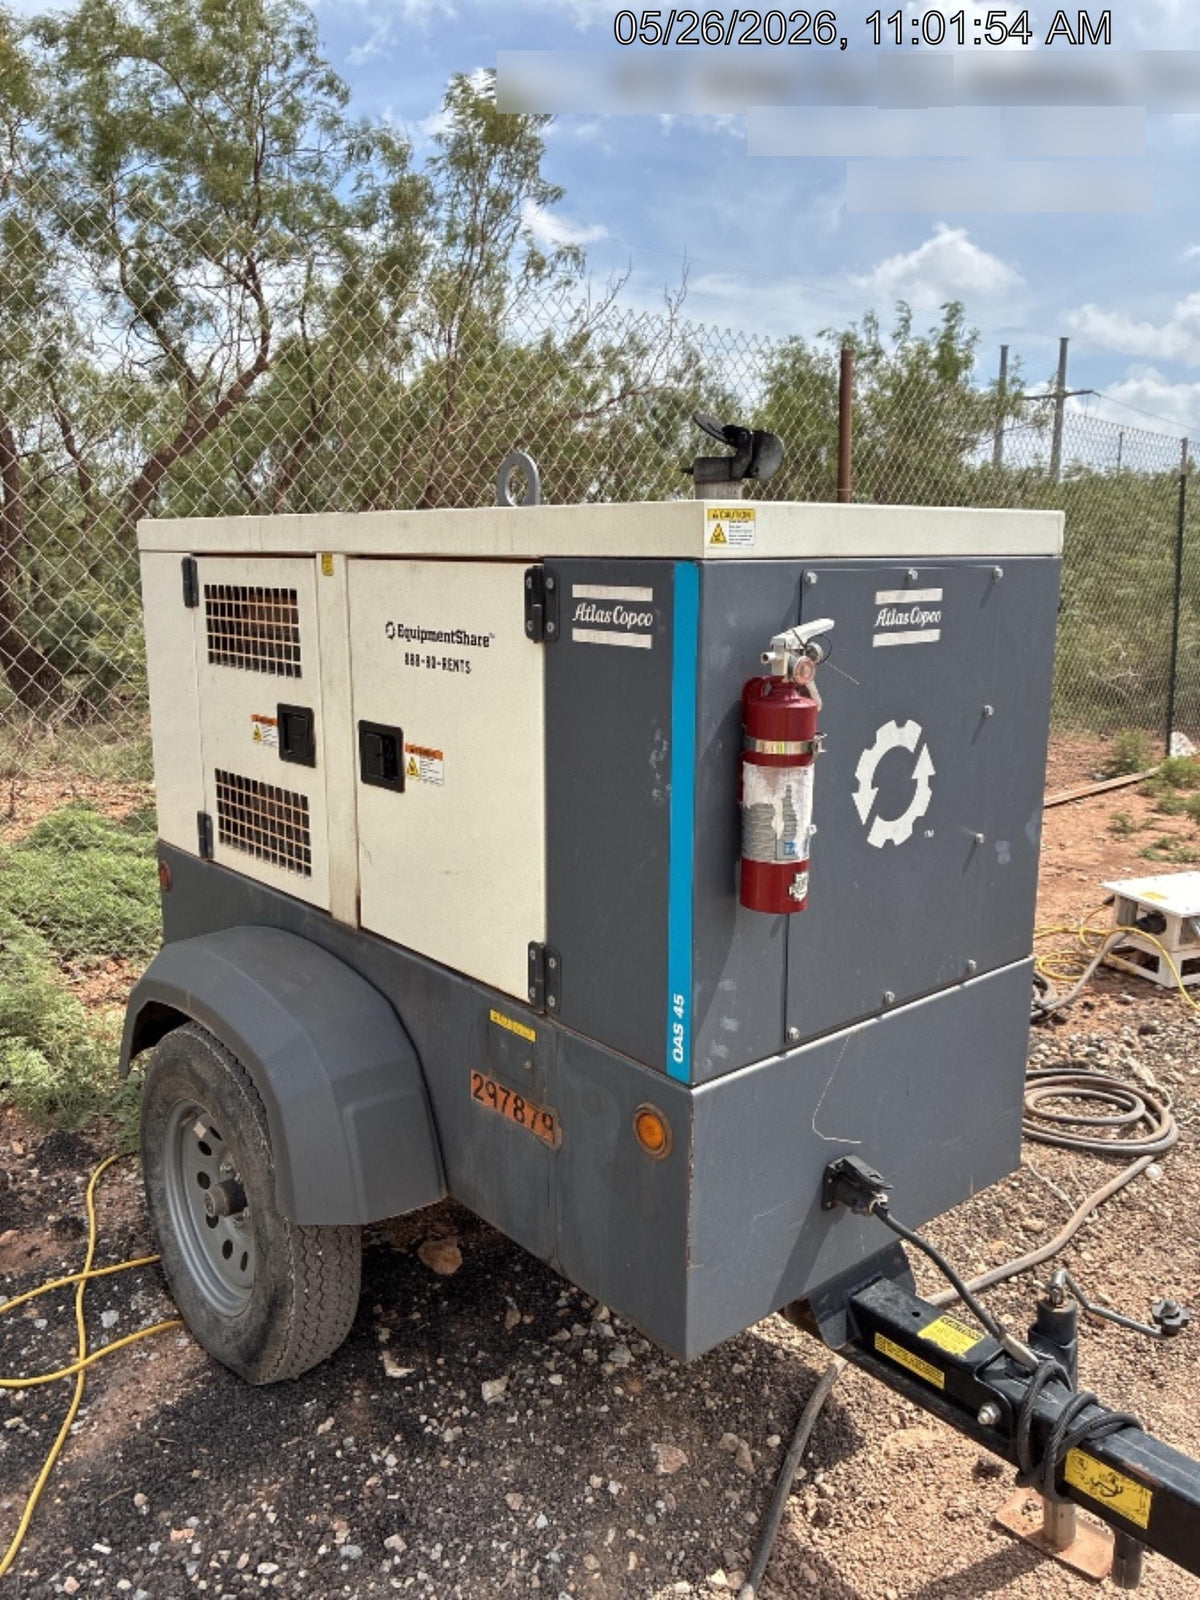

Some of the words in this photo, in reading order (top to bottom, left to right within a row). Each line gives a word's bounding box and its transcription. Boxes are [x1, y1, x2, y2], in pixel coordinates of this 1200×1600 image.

[572, 602, 612, 624] Atlas
[613, 605, 653, 630] Copco
[873, 607, 909, 628] Atlas
[910, 605, 942, 627] Copco
[672, 992, 686, 1020] 45
[671, 1022, 685, 1065] QAS
